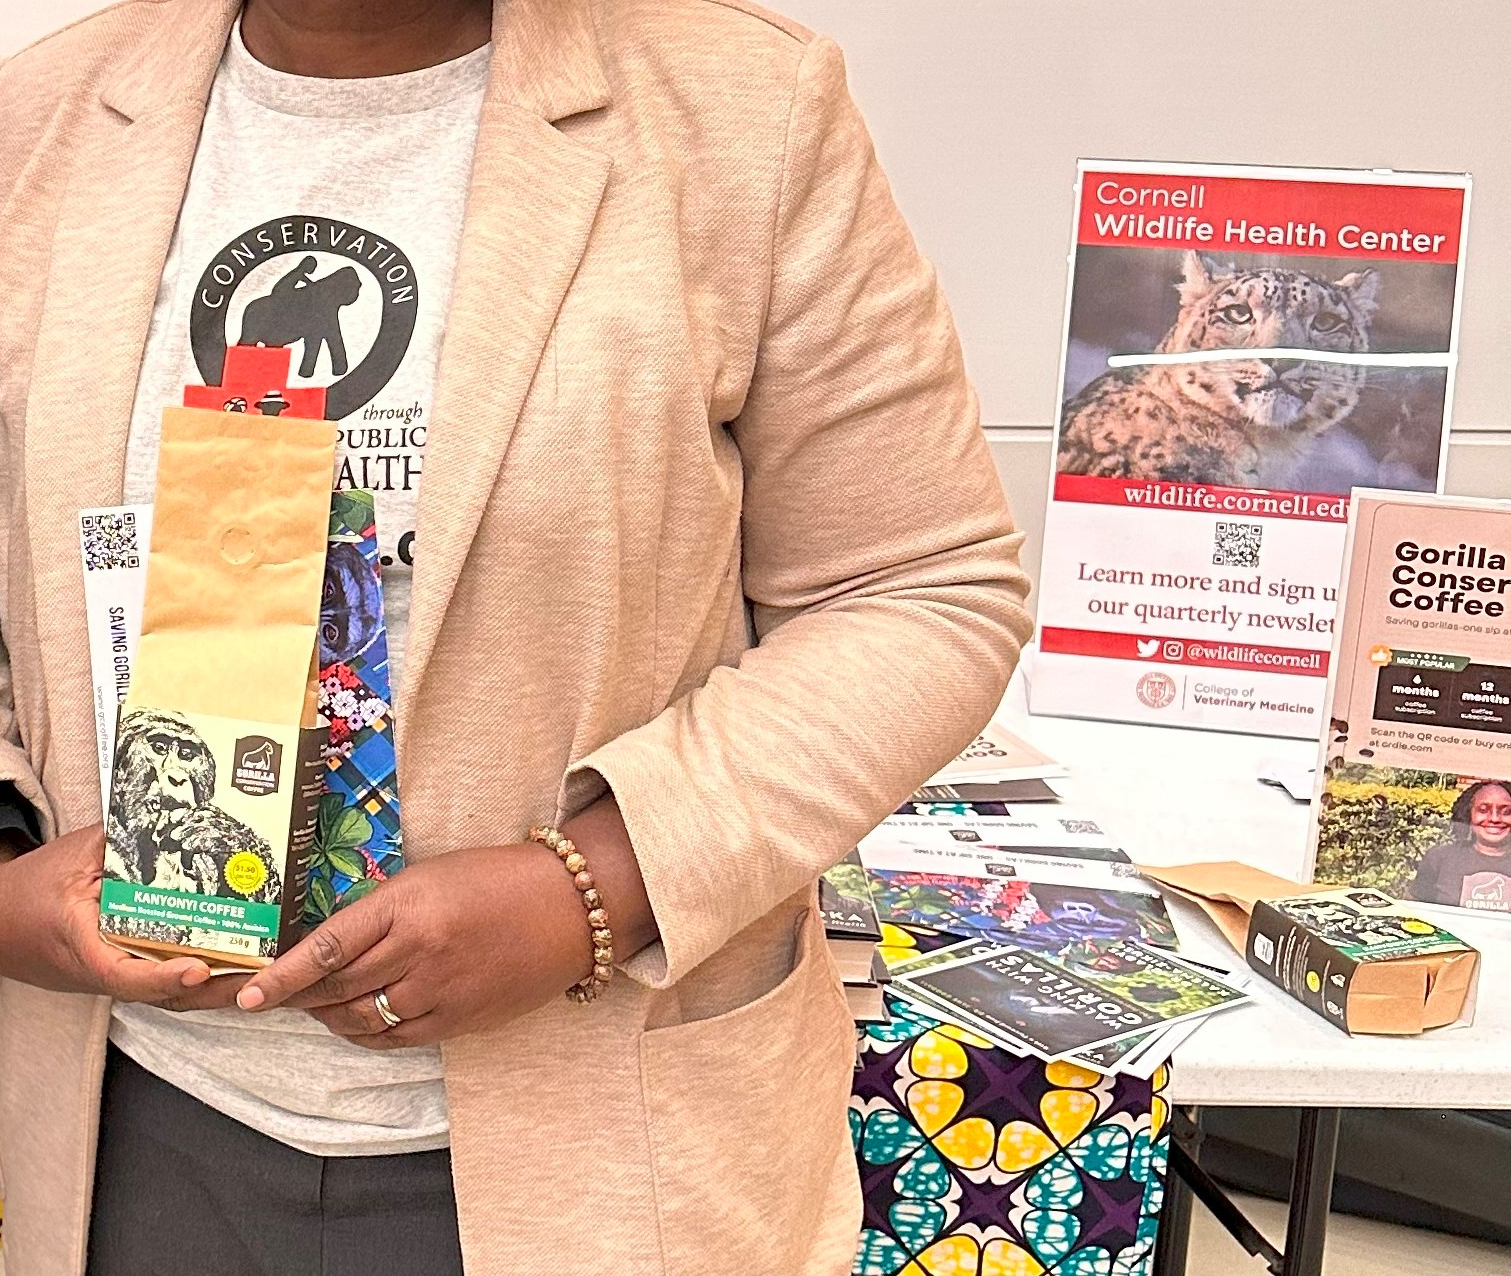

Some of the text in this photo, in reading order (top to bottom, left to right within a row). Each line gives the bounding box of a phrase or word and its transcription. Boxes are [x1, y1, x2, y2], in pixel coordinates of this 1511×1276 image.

[1096, 181, 1205, 209] Cornell
[1093, 212, 1447, 254] Wildlife Health Center
[202, 222, 414, 309] CONSERVATION
[363, 401, 423, 424] through
[334, 454, 424, 491] ALTH
[1395, 541, 1506, 570] Gorilla
[1078, 562, 1340, 605] Learn more and sign u
[1087, 598, 1336, 635] our quarterly newslet
[1389, 588, 1504, 617] Coffee
[1385, 615, 1419, 628] Saving
[109, 606, 131, 705] SAVING GORILL
[1187, 643, 1320, 669] @wildlifecornell
[1194, 683, 1255, 697] College of
[1392, 685, 1440, 698] months
[1461, 692, 1510, 705] months
[1194, 695, 1315, 714] Veterinary Medicine
[1371, 727, 1396, 737] Scan
[1398, 730, 1415, 739] the
[1417, 733, 1432, 741] QR
[1434, 736, 1460, 745] code
[1475, 738, 1494, 749] buy
[134, 891, 245, 919] KANYONYI COFFEE
[243, 939, 250, 948] g
[986, 960, 1033, 985] WITH
[1000, 955, 1143, 1025] GORILLAS
[1038, 985, 1123, 1030] WALKING
